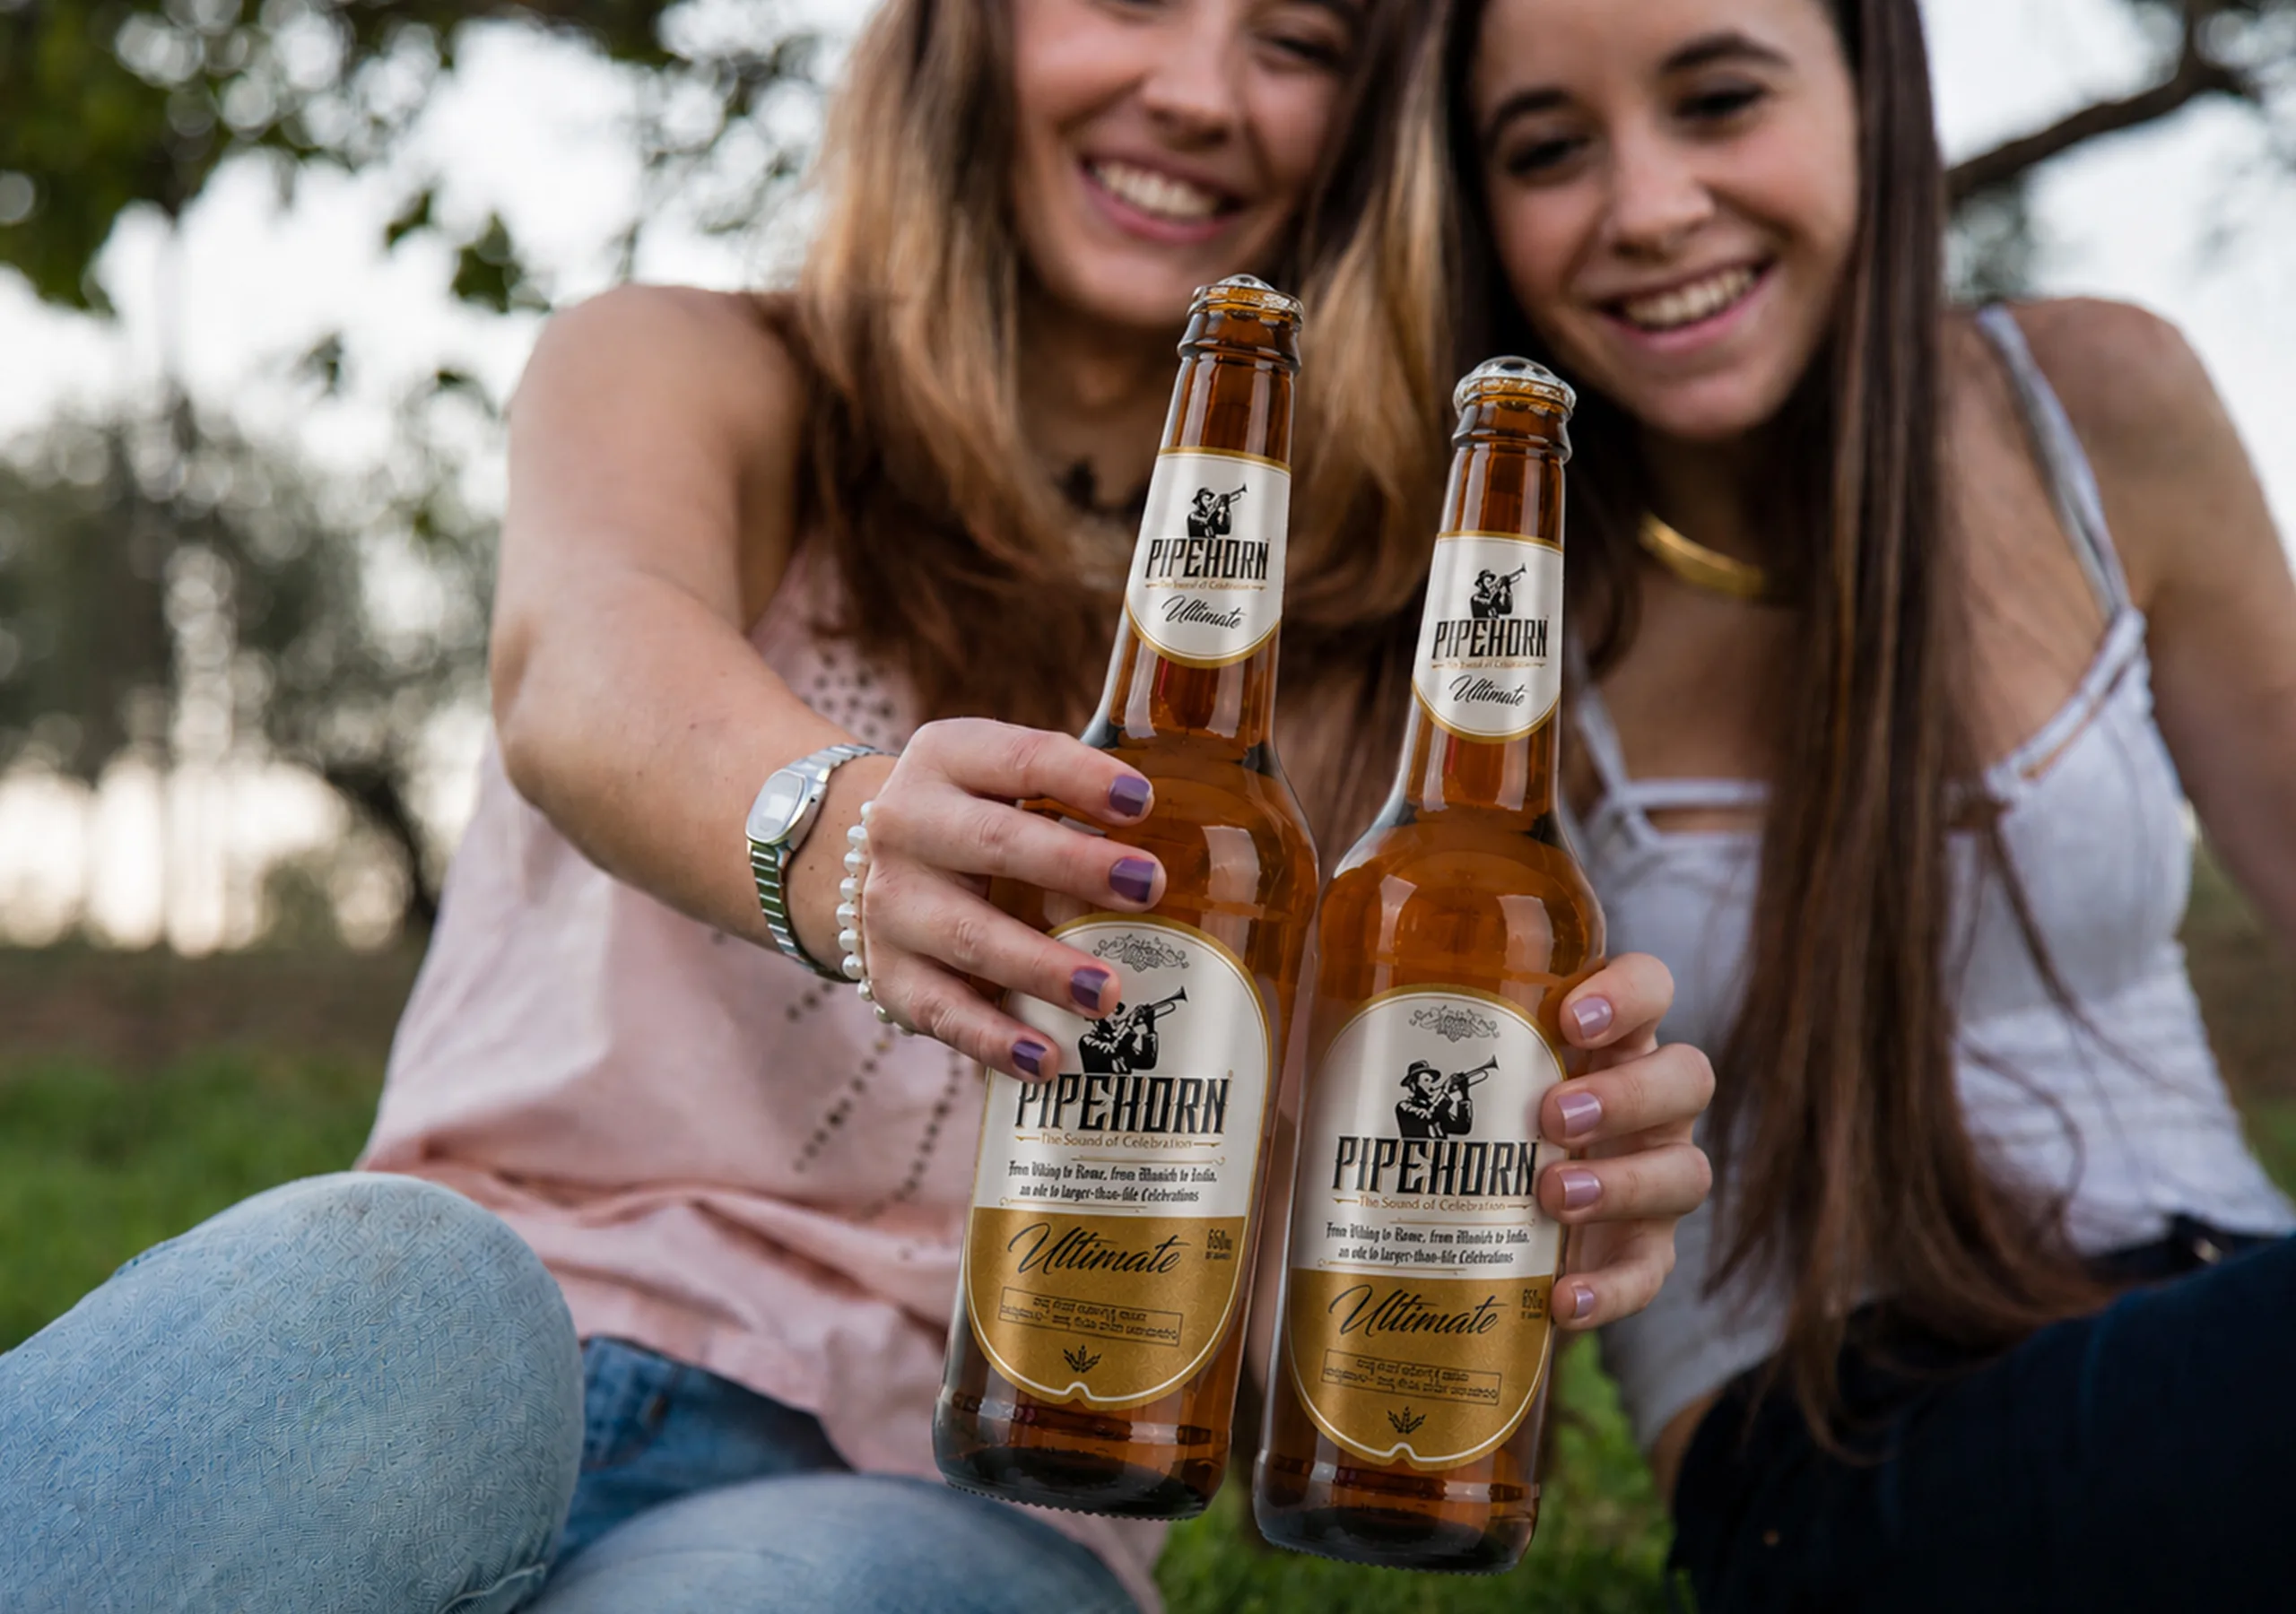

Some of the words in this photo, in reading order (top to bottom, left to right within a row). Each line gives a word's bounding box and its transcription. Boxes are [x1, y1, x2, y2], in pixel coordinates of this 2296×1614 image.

[1144, 537, 1270, 580] PIPEHORN
[1161, 594, 1247, 629] Ultimate
[1431, 619, 1549, 660] PIPEHORN
[1448, 674, 1529, 707] Ultimate
[1014, 1073, 1231, 1135] PIPEHORN
[1041, 1132, 1063, 1145] The
[1064, 1132, 1103, 1148] Sound
[1105, 1135, 1119, 1148] of
[1123, 1135, 1192, 1150] Celebration
[1063, 1165, 1073, 1178] to
[1109, 1165, 1135, 1181] from
[1179, 1168, 1189, 1182] to
[1332, 1136, 1539, 1197] PIPEHORN
[1019, 1184, 1031, 1196] an
[1032, 1184, 1048, 1197] ode
[1049, 1184, 1060, 1197] to
[1141, 1187, 1199, 1202] Celebrations
[1359, 1195, 1379, 1208] The
[1381, 1196, 1420, 1210] Sound
[1422, 1199, 1435, 1210] of
[1439, 1198, 1506, 1212] Celebration
[1007, 1222, 1191, 1275] Ultimate
[1381, 1228, 1392, 1241] to
[1429, 1228, 1454, 1244] from
[1495, 1231, 1504, 1244] to
[1338, 1247, 1350, 1258] an
[1352, 1246, 1368, 1260] ode
[1369, 1246, 1379, 1260] to
[1458, 1249, 1514, 1264] Celebrations
[1328, 1284, 1509, 1337] Ultimate
